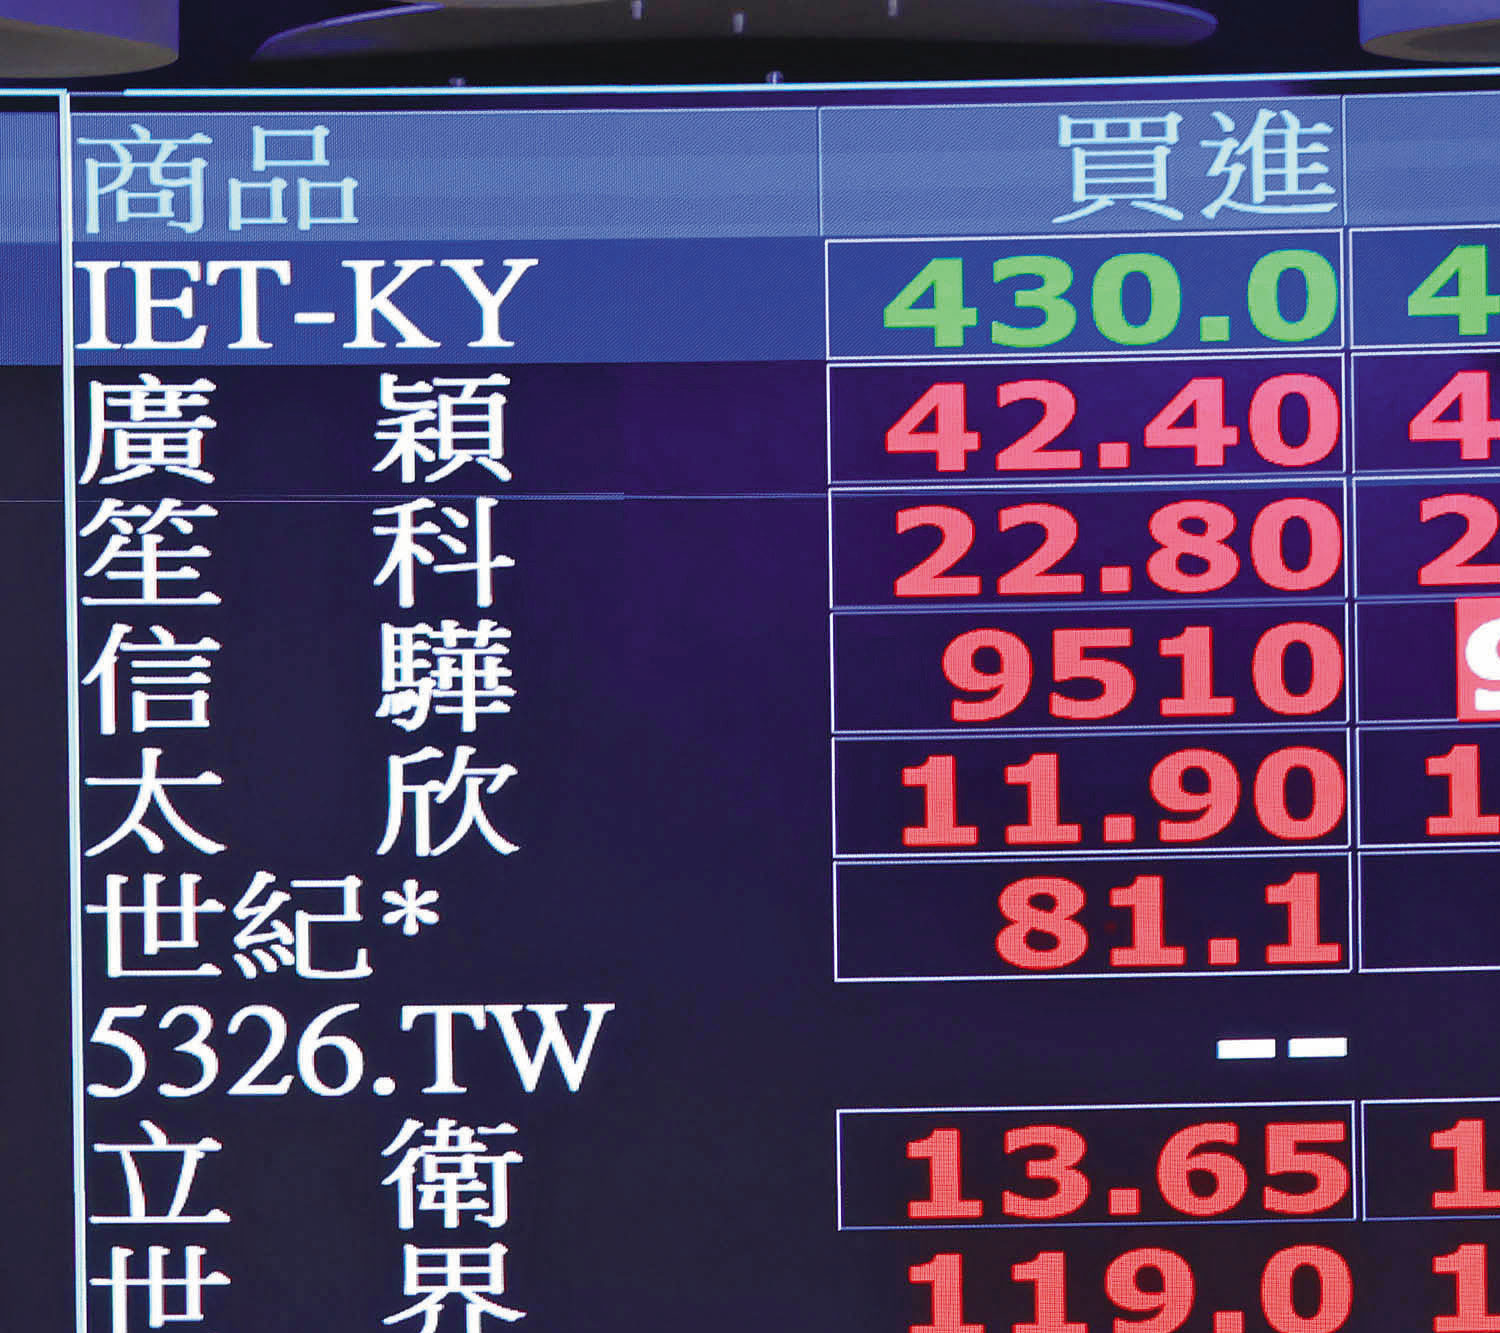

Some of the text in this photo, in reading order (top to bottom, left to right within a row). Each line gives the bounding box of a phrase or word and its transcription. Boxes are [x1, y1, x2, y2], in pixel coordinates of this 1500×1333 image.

[76, 124, 361, 233] 商品
[1052, 108, 1339, 226] 買進
[71, 258, 539, 355] IET-KY
[883, 249, 1338, 348] 430.0
[941, 621, 1344, 723] 9510
[995, 871, 1342, 971] 81.1
[87, 1003, 616, 1098] 5326.TW
